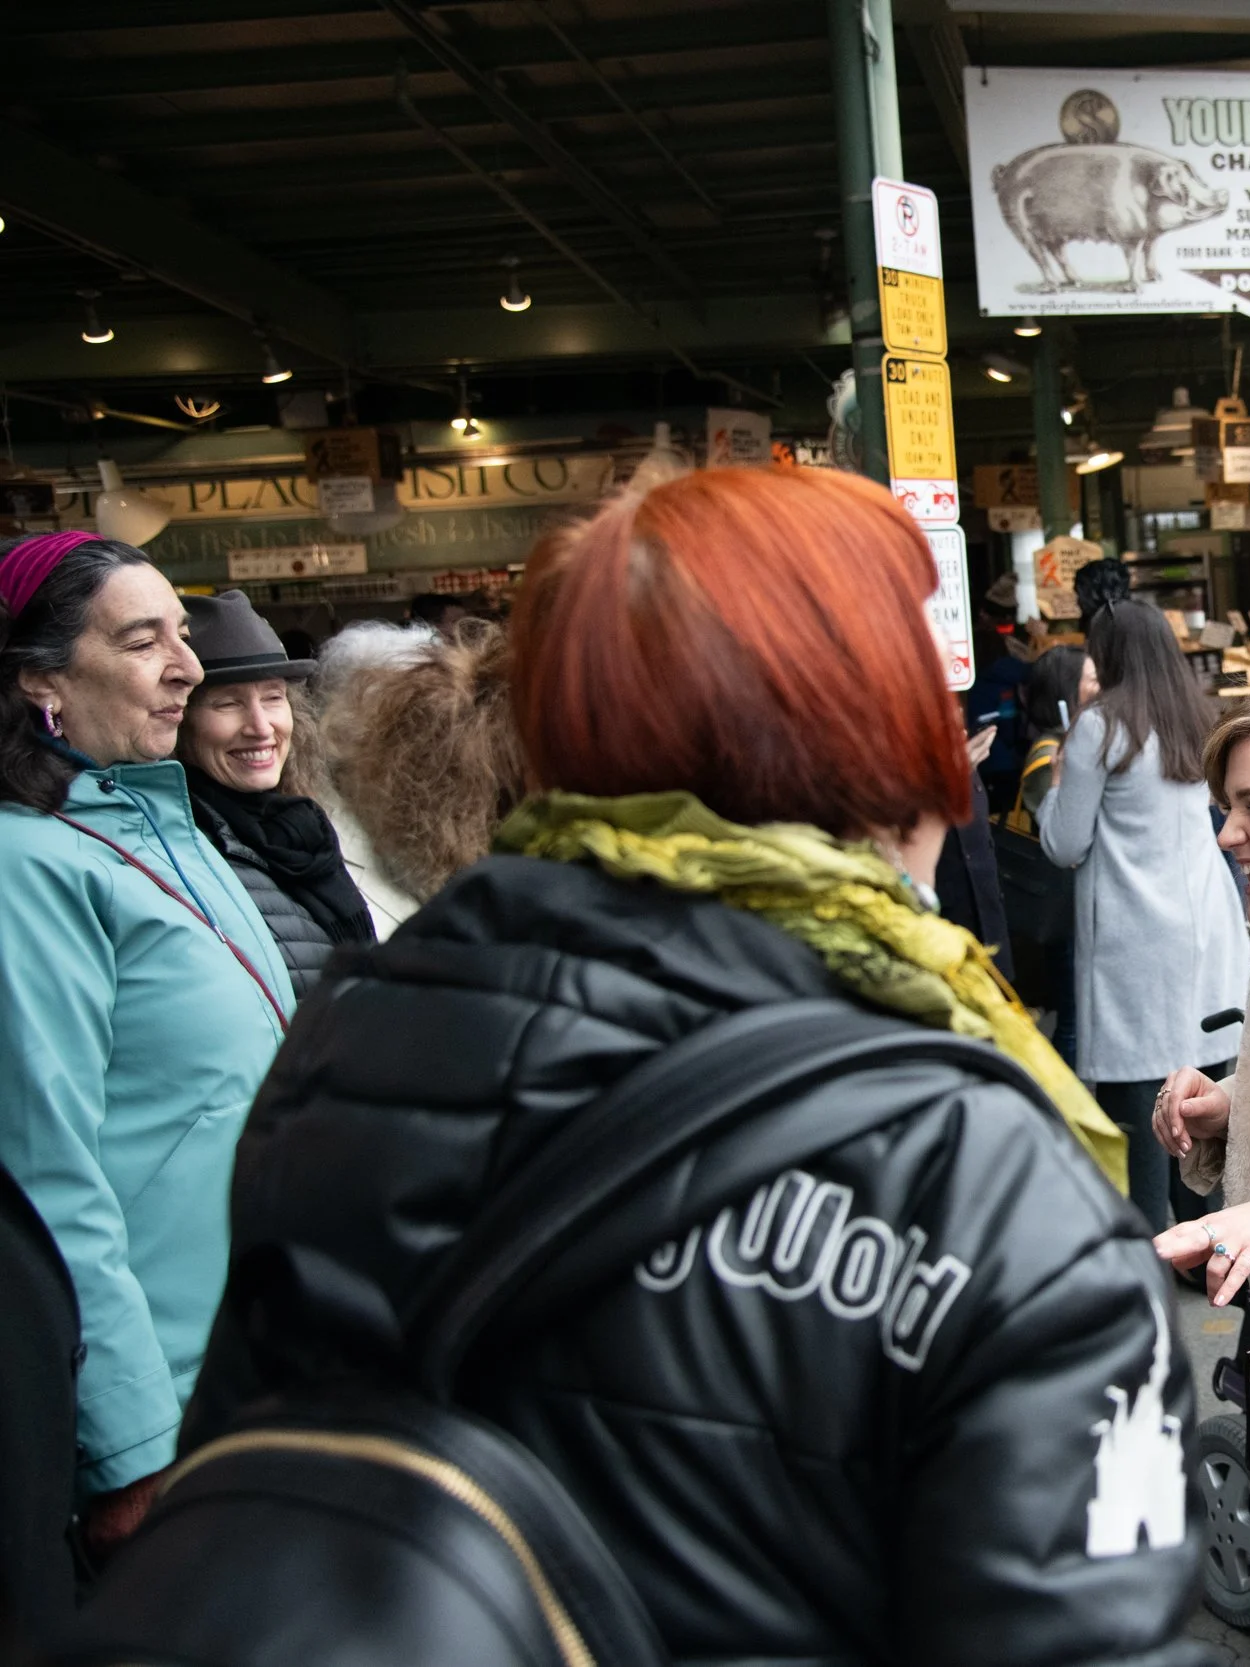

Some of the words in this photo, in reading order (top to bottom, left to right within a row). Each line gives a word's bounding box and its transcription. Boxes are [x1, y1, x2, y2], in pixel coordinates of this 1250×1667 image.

[888, 362, 905, 381] 30
[896, 389, 921, 405] LOAD
[925, 391, 942, 408] AND
[901, 409, 939, 426] UNLOAD
[909, 430, 935, 447] ONLY
[184, 476, 326, 512] PLAC
[409, 464, 491, 499] ISH
